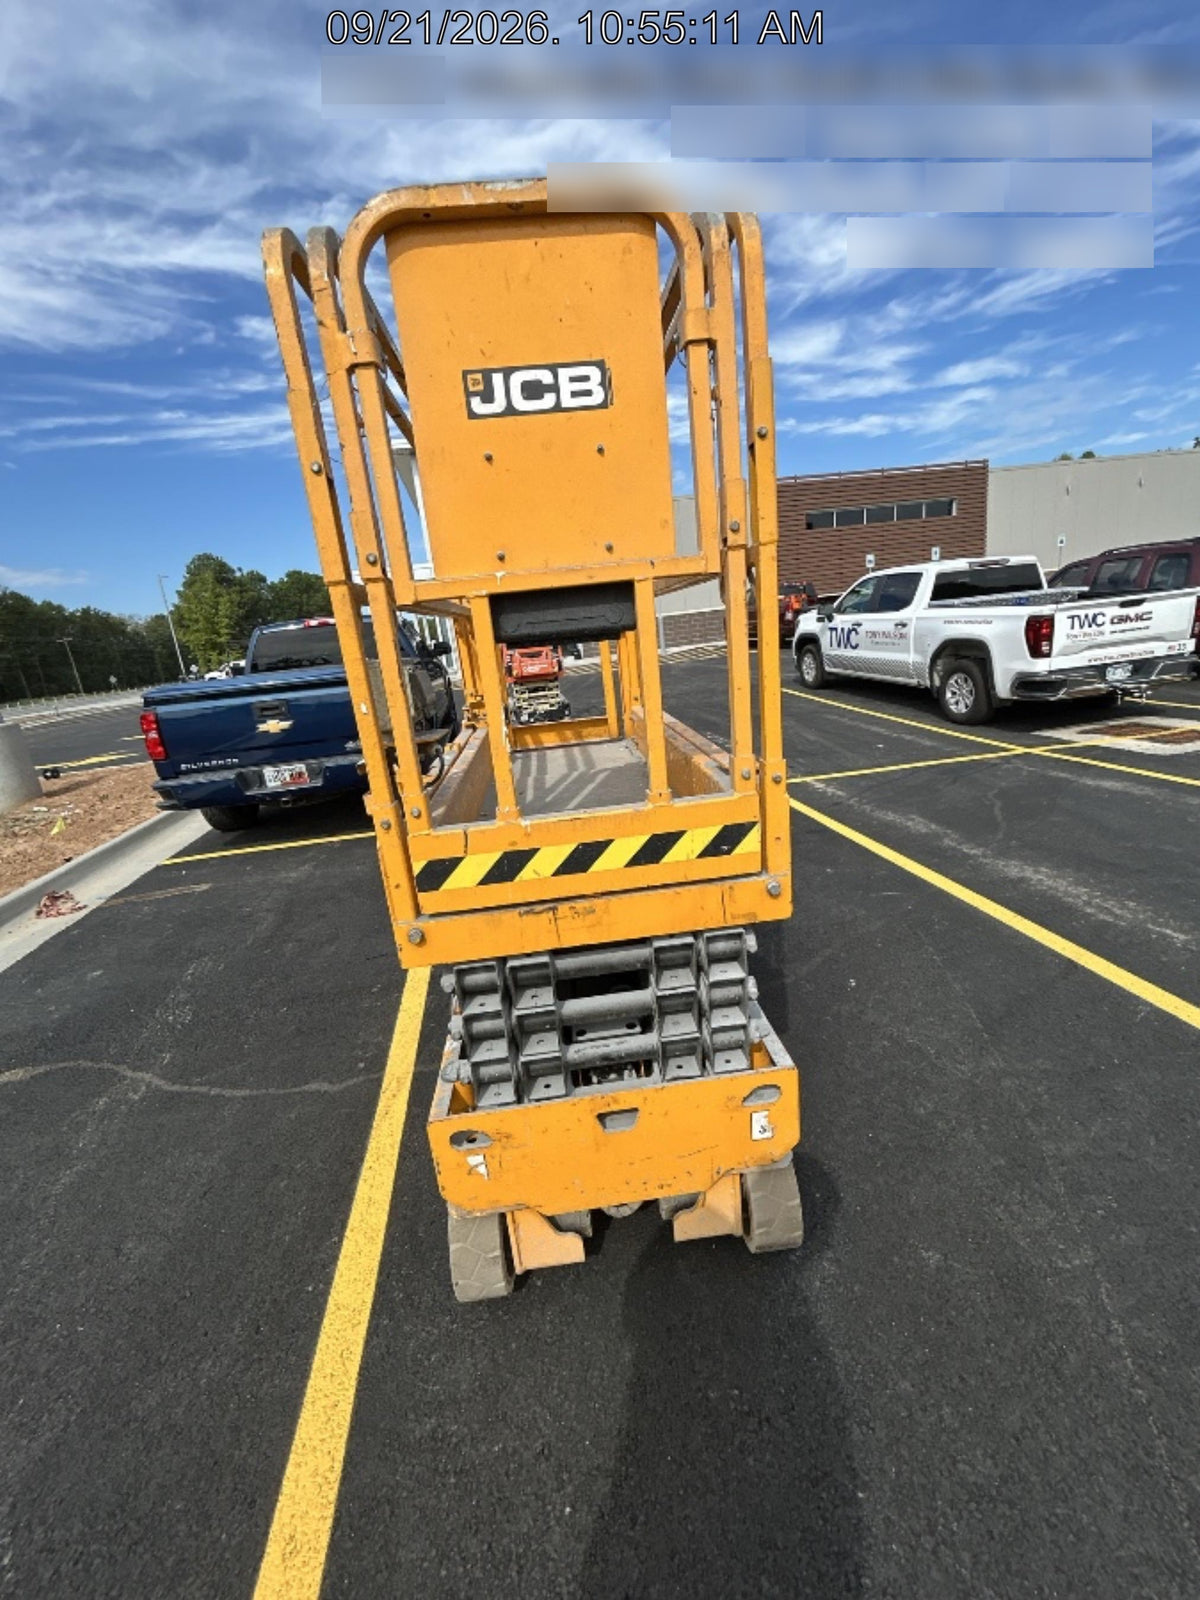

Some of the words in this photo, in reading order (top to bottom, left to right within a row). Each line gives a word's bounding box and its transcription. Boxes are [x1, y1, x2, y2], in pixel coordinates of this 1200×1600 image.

[470, 365, 605, 415] JCB
[1066, 612, 1106, 630] TWC
[1110, 611, 1153, 625] GMC
[828, 626, 860, 650] TWC
